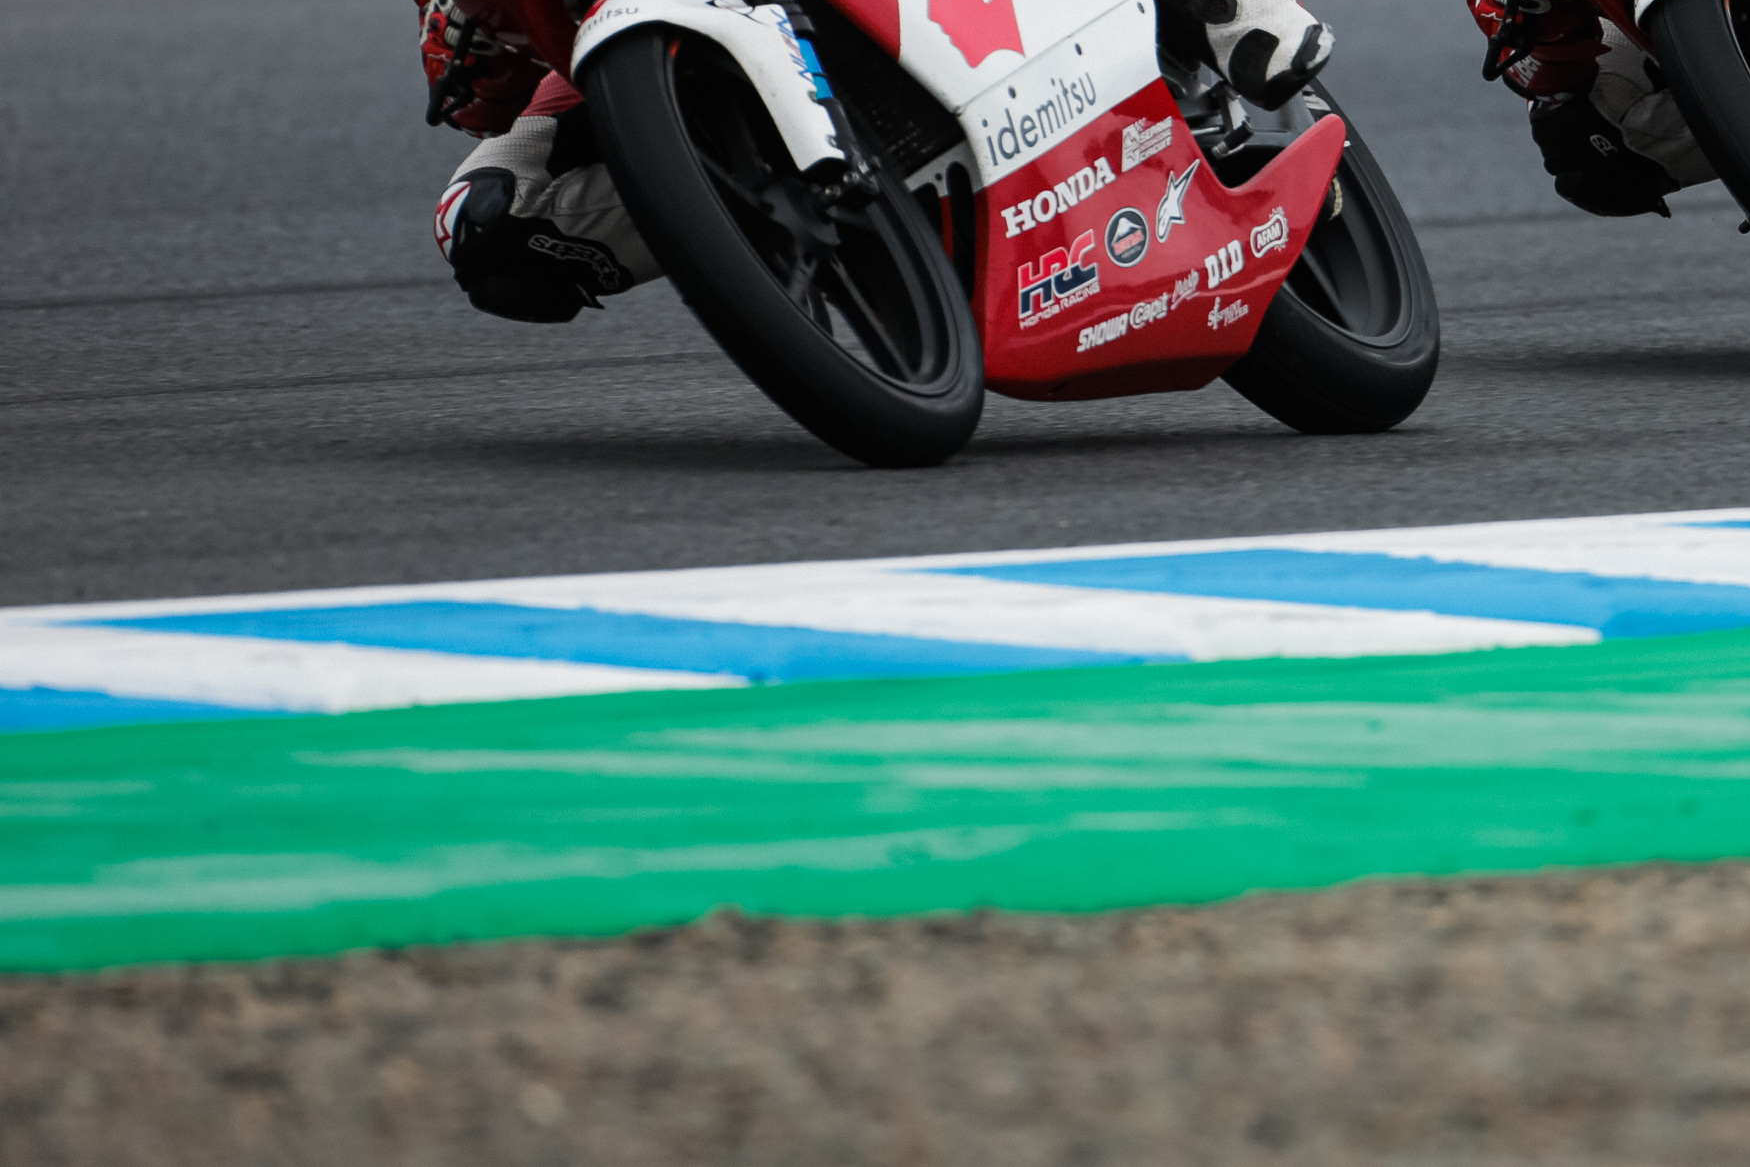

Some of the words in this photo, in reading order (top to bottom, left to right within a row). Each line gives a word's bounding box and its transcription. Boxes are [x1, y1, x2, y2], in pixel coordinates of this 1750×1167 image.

[981, 71, 1097, 167] idemitsu
[1000, 156, 1117, 238] HONDA
[1256, 221, 1281, 249] AFAM
[1020, 304, 1060, 331] Honda
[1060, 281, 1101, 309] RACING
[1076, 312, 1129, 353] SHOWA
